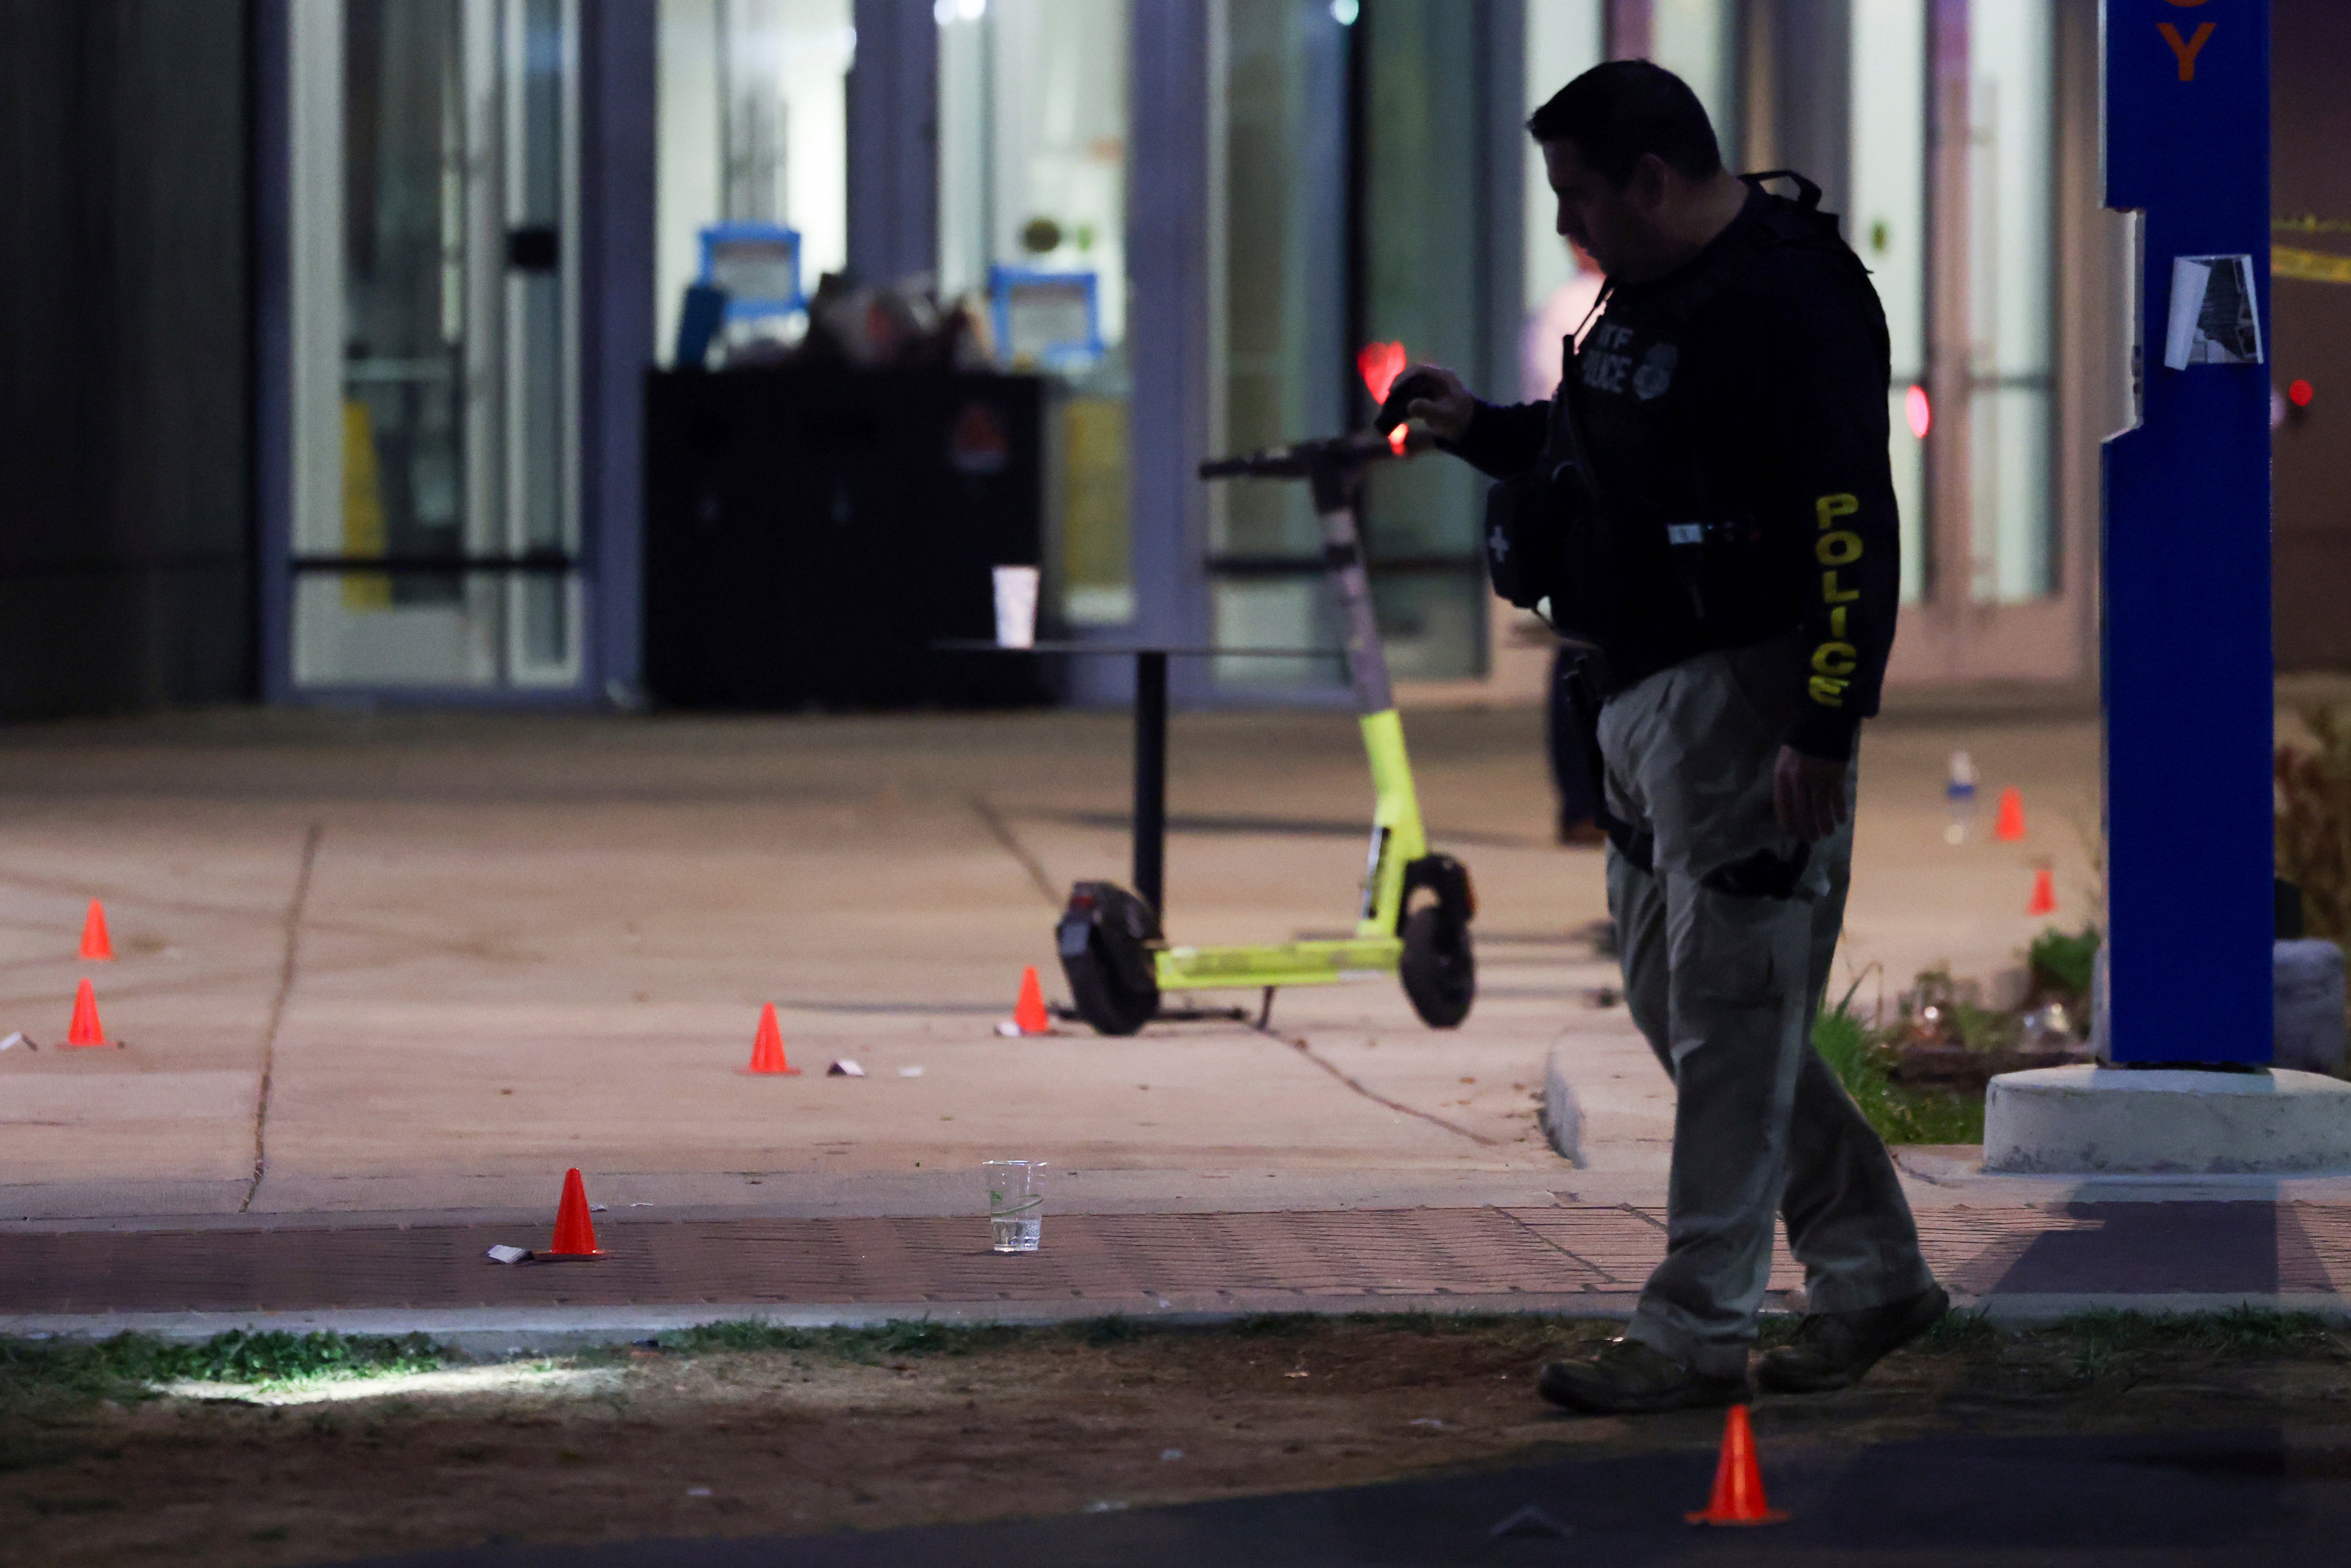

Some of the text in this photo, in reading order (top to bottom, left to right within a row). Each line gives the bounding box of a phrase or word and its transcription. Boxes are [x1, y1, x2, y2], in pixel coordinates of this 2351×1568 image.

[2155, 0, 2217, 81] Y
[1596, 323, 1634, 349] TF
[1808, 492, 1864, 708] POLICE
